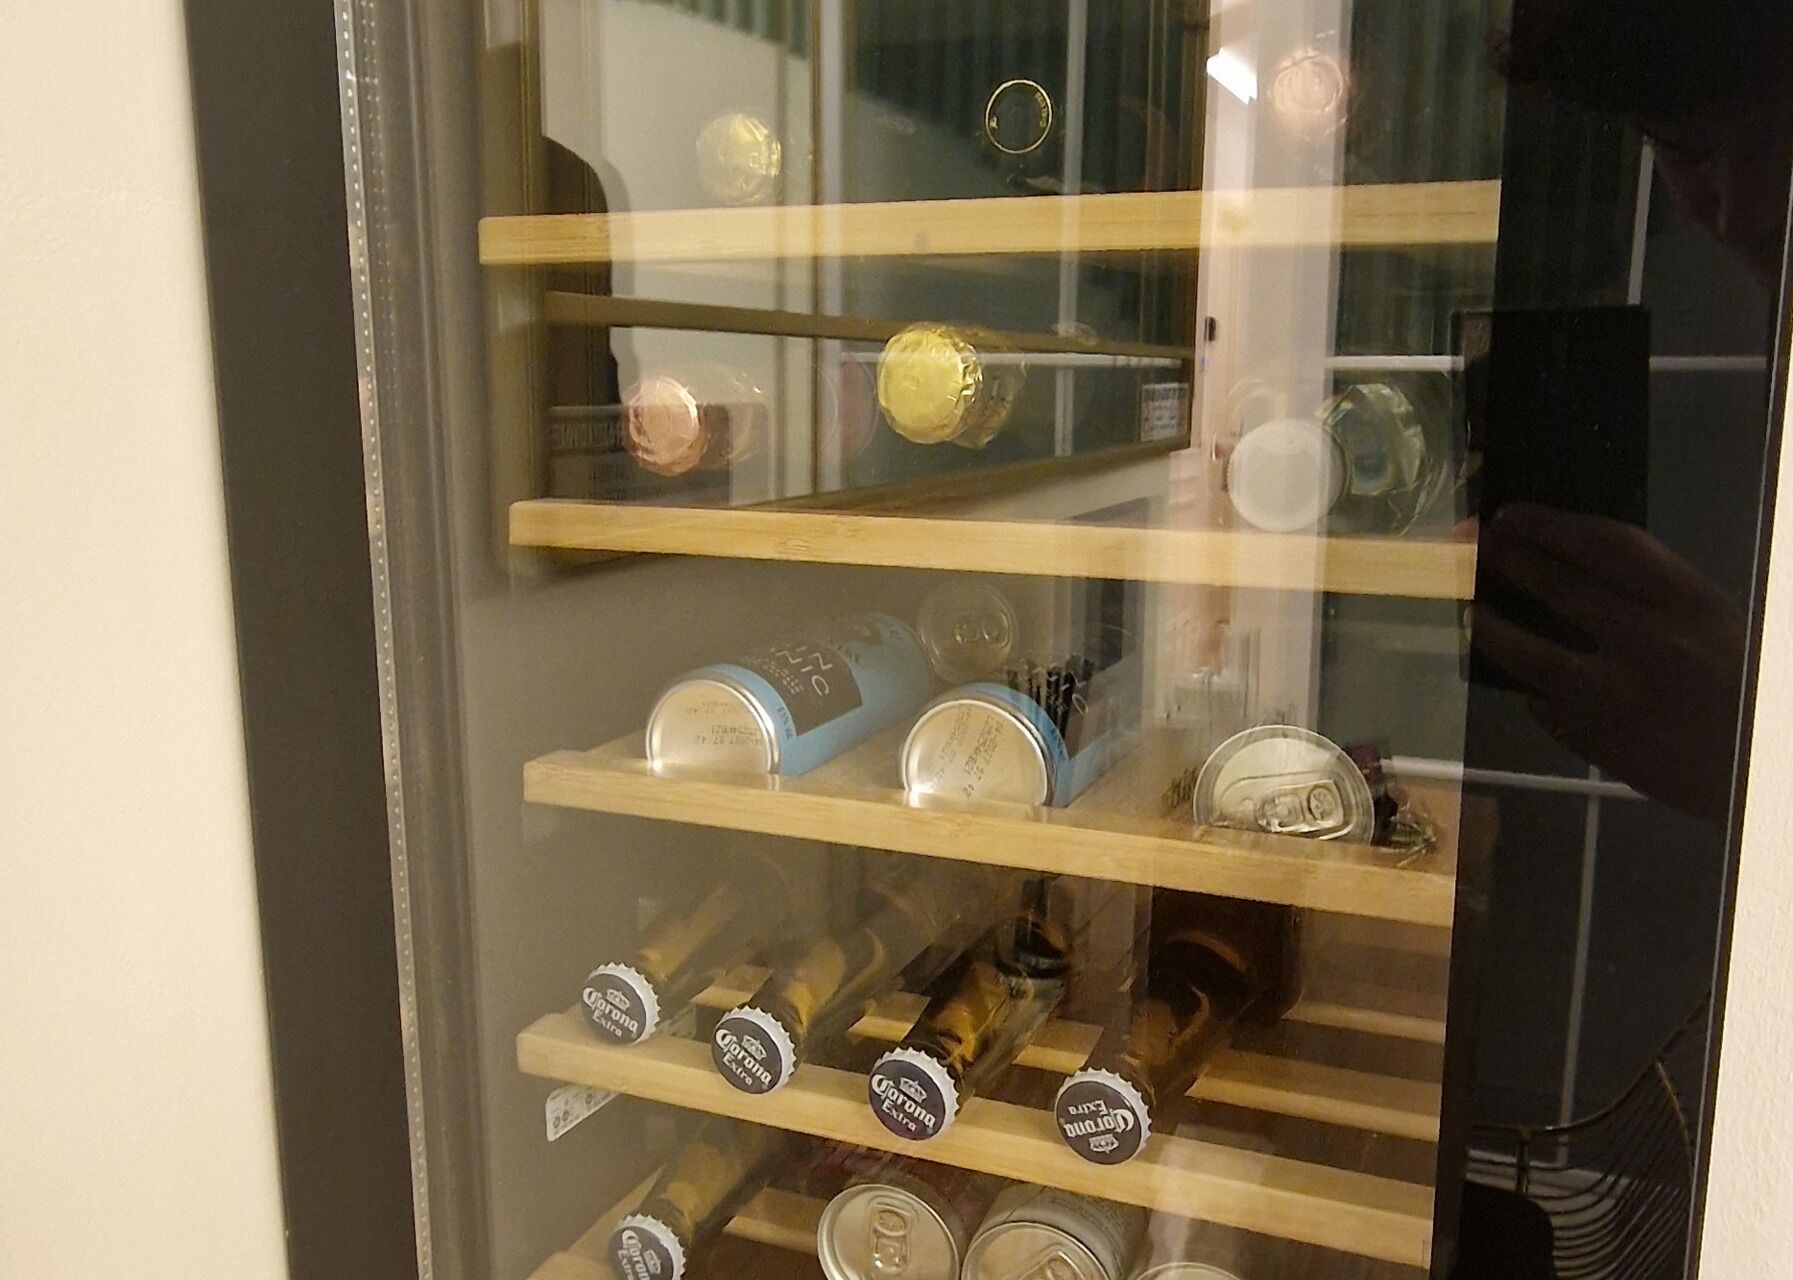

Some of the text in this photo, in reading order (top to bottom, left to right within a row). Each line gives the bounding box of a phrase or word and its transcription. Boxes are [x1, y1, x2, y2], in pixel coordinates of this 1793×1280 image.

[582, 987, 639, 1034] Corona
[592, 1010, 623, 1038] Extra
[715, 1028, 773, 1083] Corona
[722, 1055, 753, 1086] Extra
[871, 1074, 936, 1128] Corona
[881, 1100, 917, 1132] Extra
[1067, 1099, 1107, 1115] Extra
[1063, 1107, 1135, 1138] Corona
